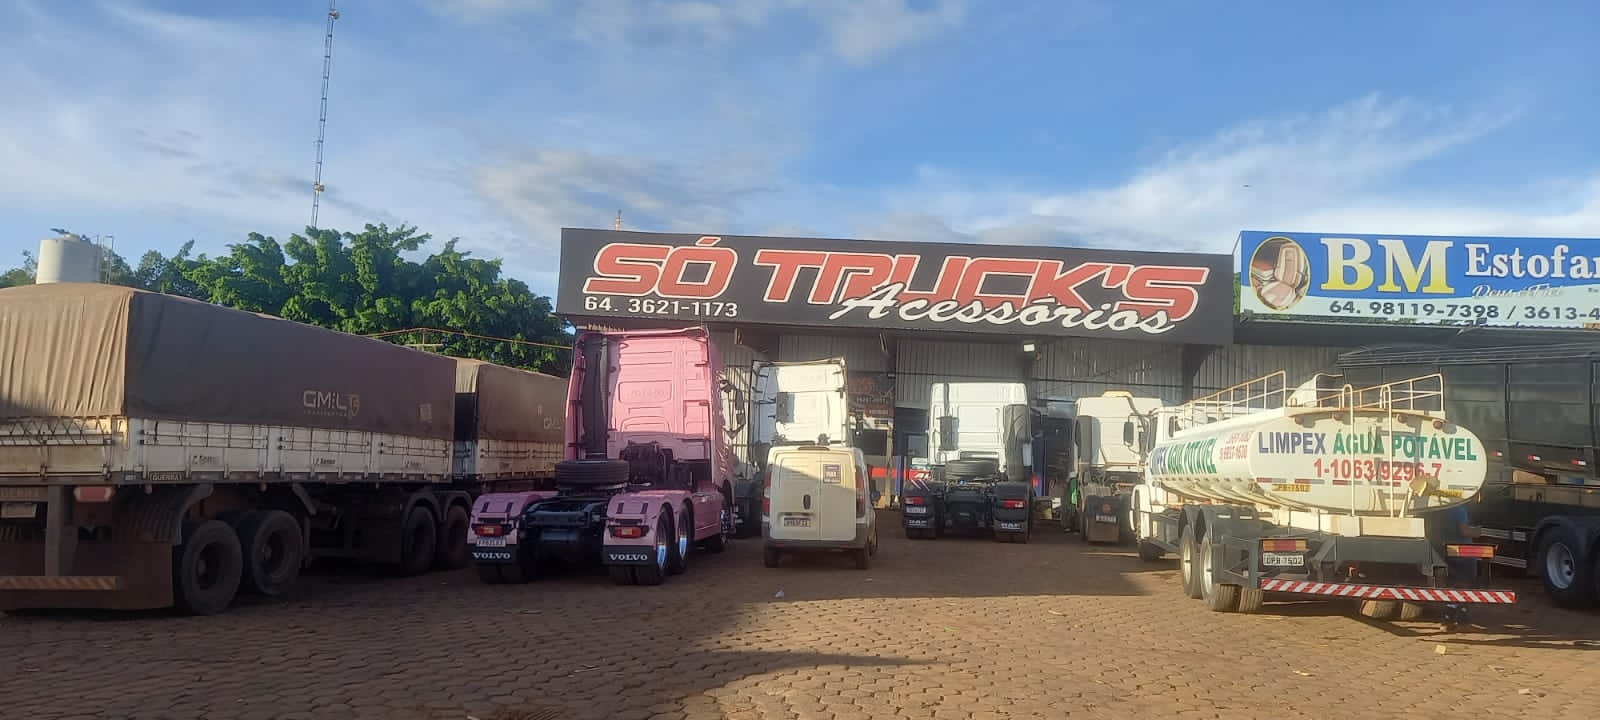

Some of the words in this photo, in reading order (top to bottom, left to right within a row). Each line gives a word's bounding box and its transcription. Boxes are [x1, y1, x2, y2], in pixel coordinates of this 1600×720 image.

[583, 236, 738, 300] SÓ
[753, 249, 1210, 322] TRUCK'S
[1319, 237, 1455, 294] BM
[584, 296, 619, 312] 64.
[627, 298, 738, 317] 3621-1173
[828, 281, 1176, 334] Acessórios
[1329, 300, 1361, 314] 64.
[1369, 301, 1499, 318] 98119-7398
[1506, 305, 1517, 319] /
[1523, 305, 1600, 320] 3613-4
[1258, 432, 1326, 455] LIMPEX
[1333, 428, 1385, 455] ÁGUA
[1391, 433, 1477, 461] POTÁVEL
[1313, 458, 1443, 481] 1-1063/9296-7
